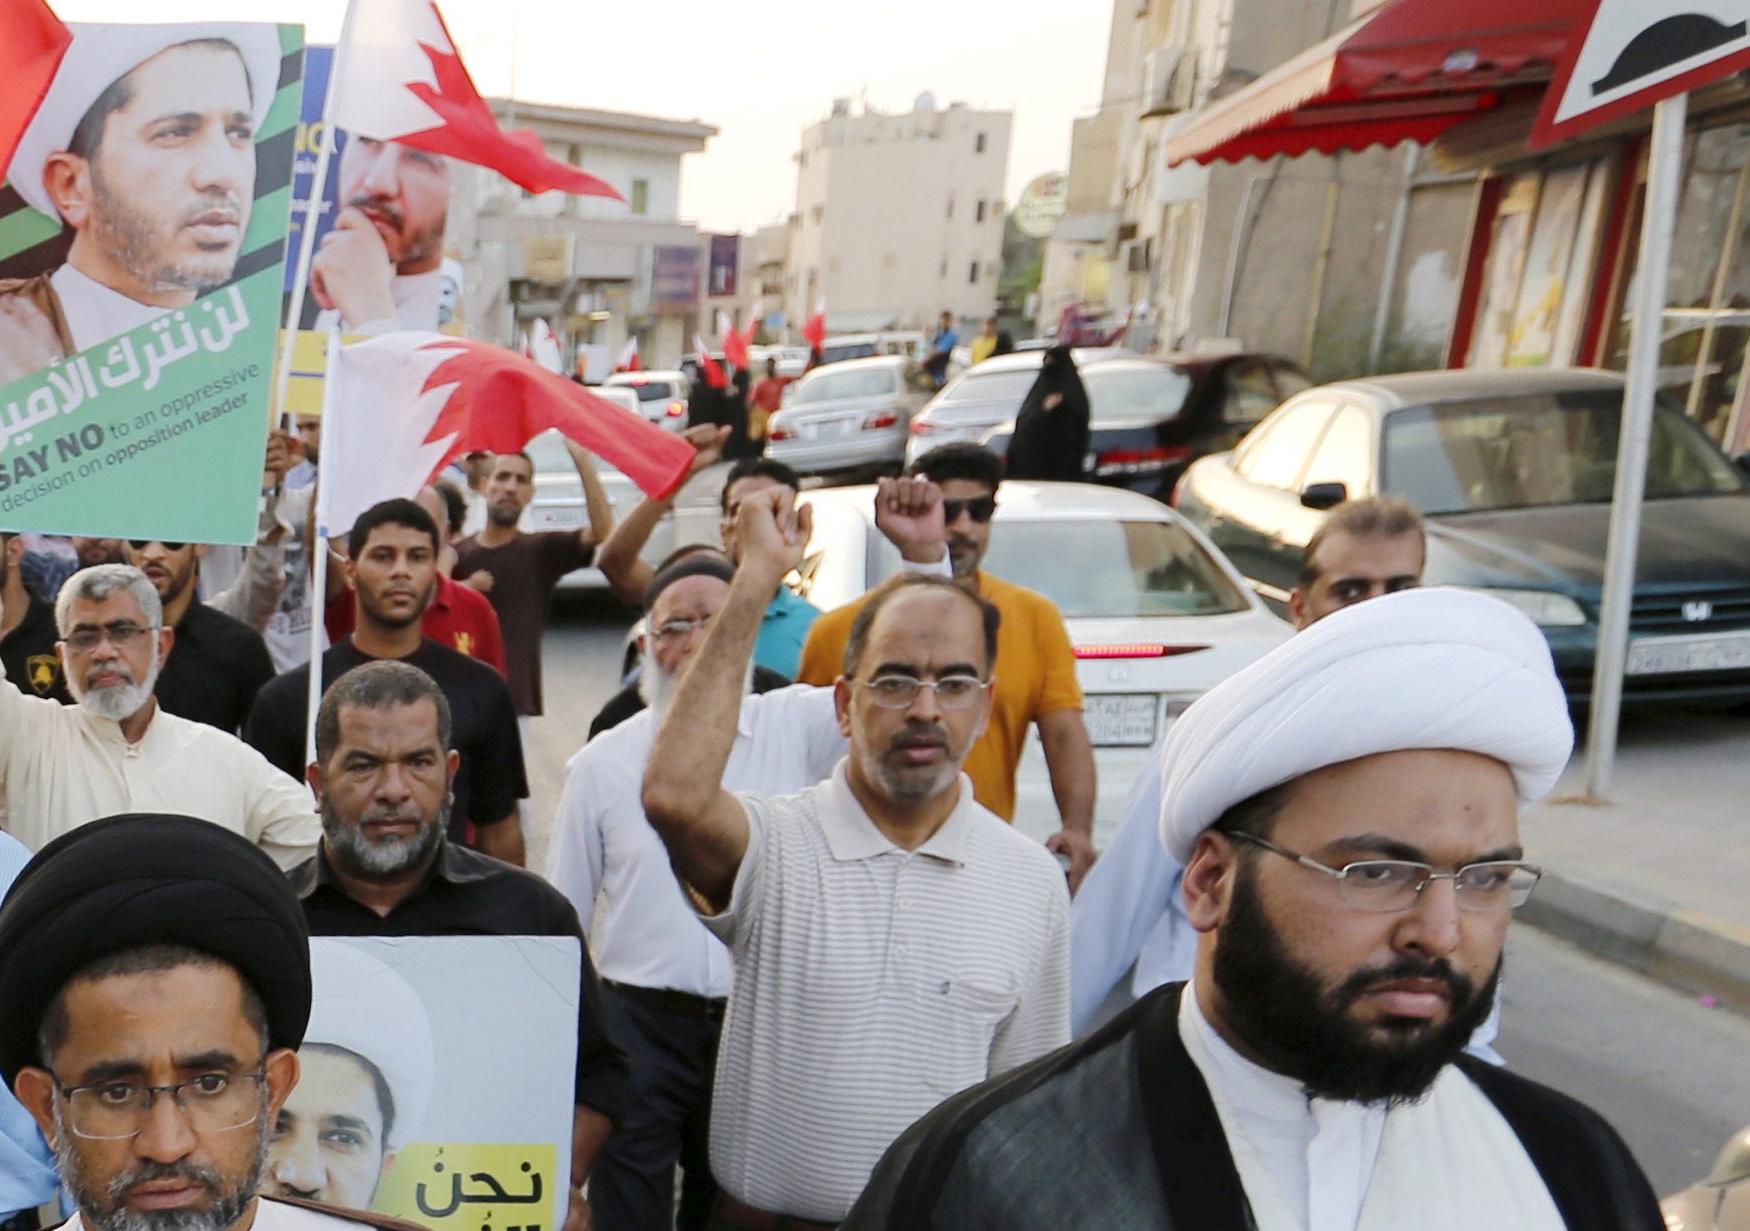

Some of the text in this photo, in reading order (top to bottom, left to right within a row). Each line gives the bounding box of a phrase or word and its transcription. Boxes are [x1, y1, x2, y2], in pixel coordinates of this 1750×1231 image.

[100, 310, 198, 391] نترك
[200, 284, 250, 353] لن
[1, 391, 249, 512] decision on opposition leader
[55, 423, 105, 464] NO
[110, 420, 130, 440] to
[134, 409, 158, 430] an
[161, 361, 260, 418] oppressive
